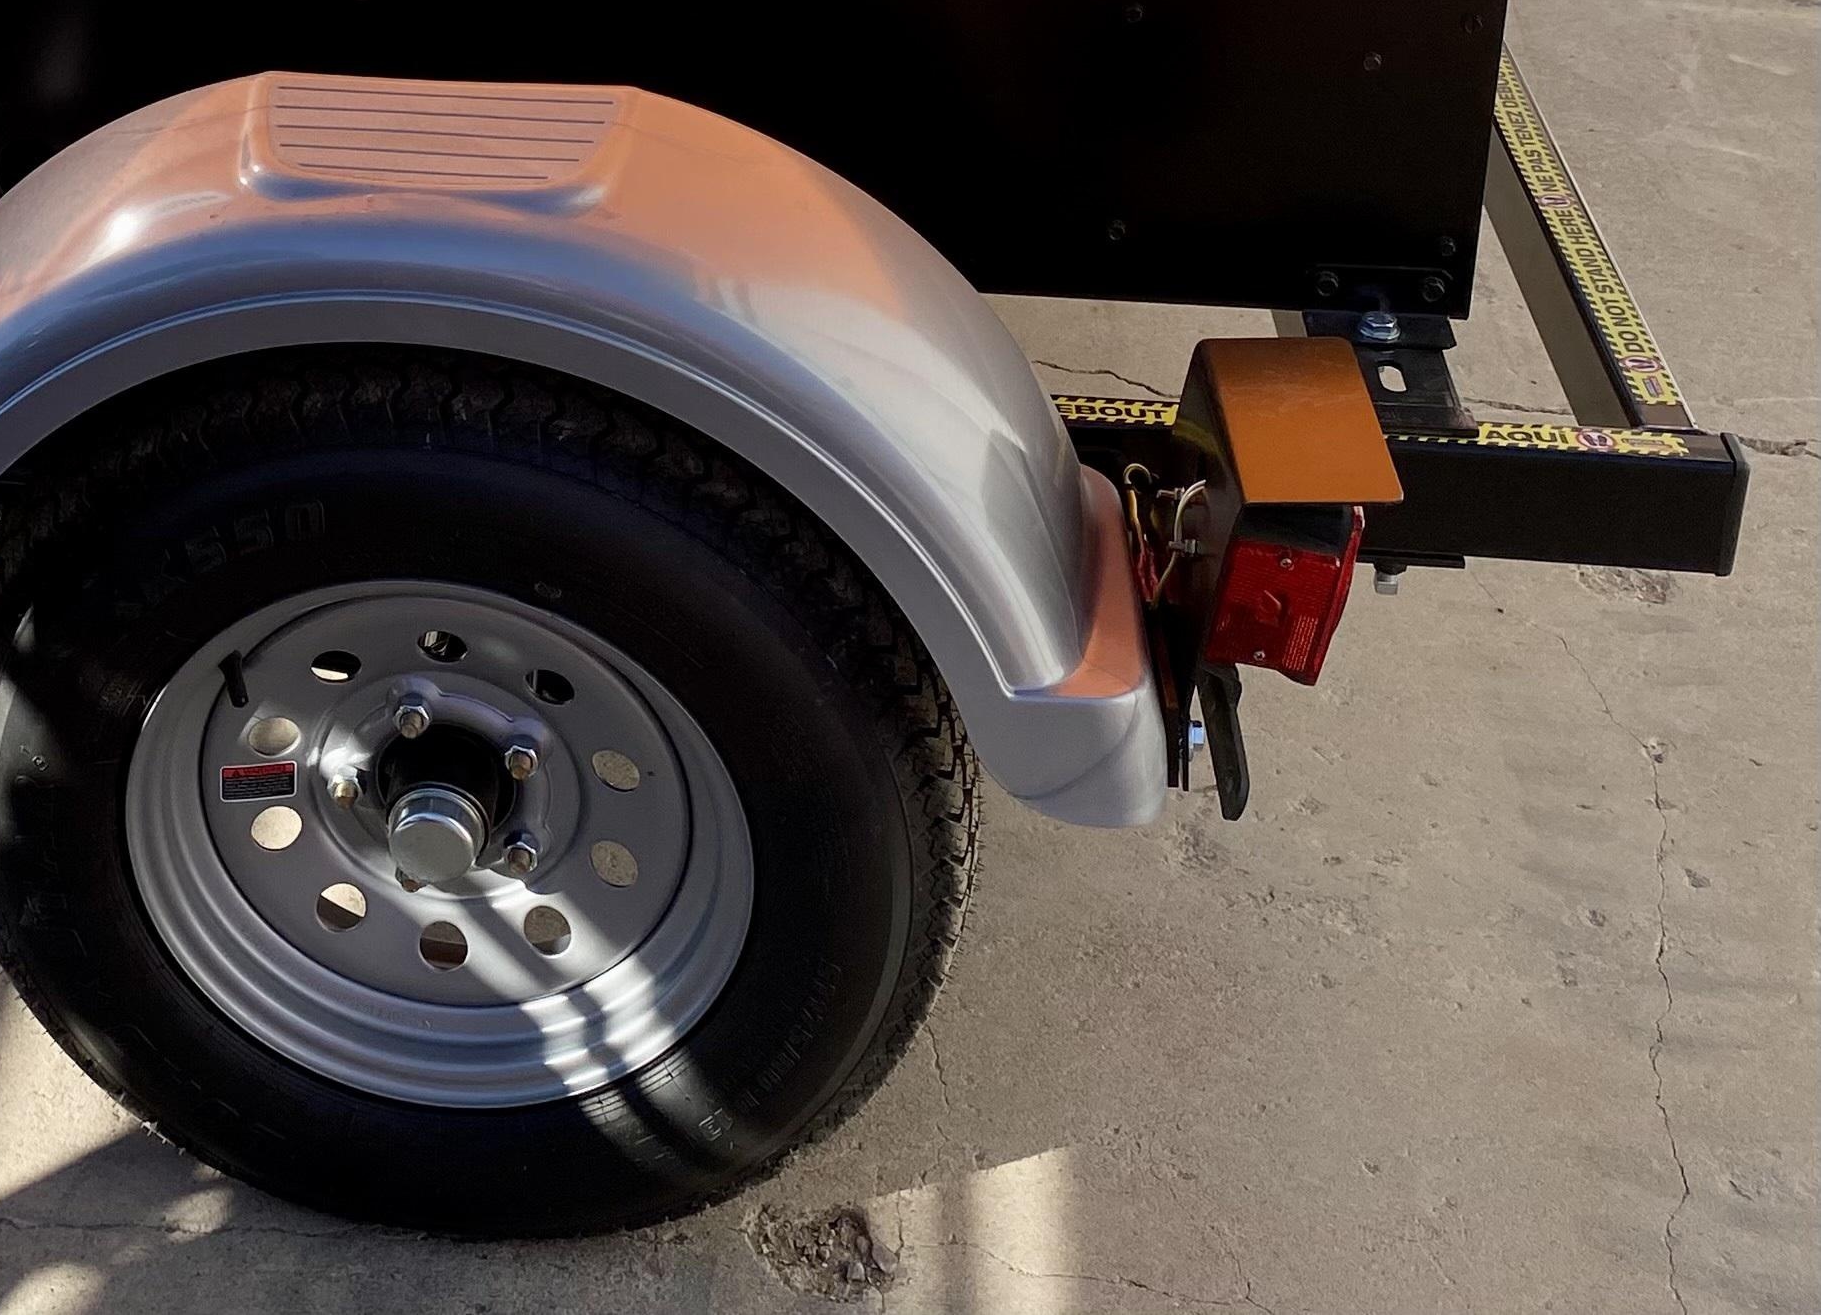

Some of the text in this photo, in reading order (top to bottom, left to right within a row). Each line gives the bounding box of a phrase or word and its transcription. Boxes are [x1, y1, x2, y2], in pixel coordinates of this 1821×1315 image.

[1506, 111, 1535, 147] TENEZ
[1523, 149, 1551, 174] PAS
[1553, 209, 1646, 353] DO NOT STAND HERE
[1056, 404, 1168, 420] EBOUT
